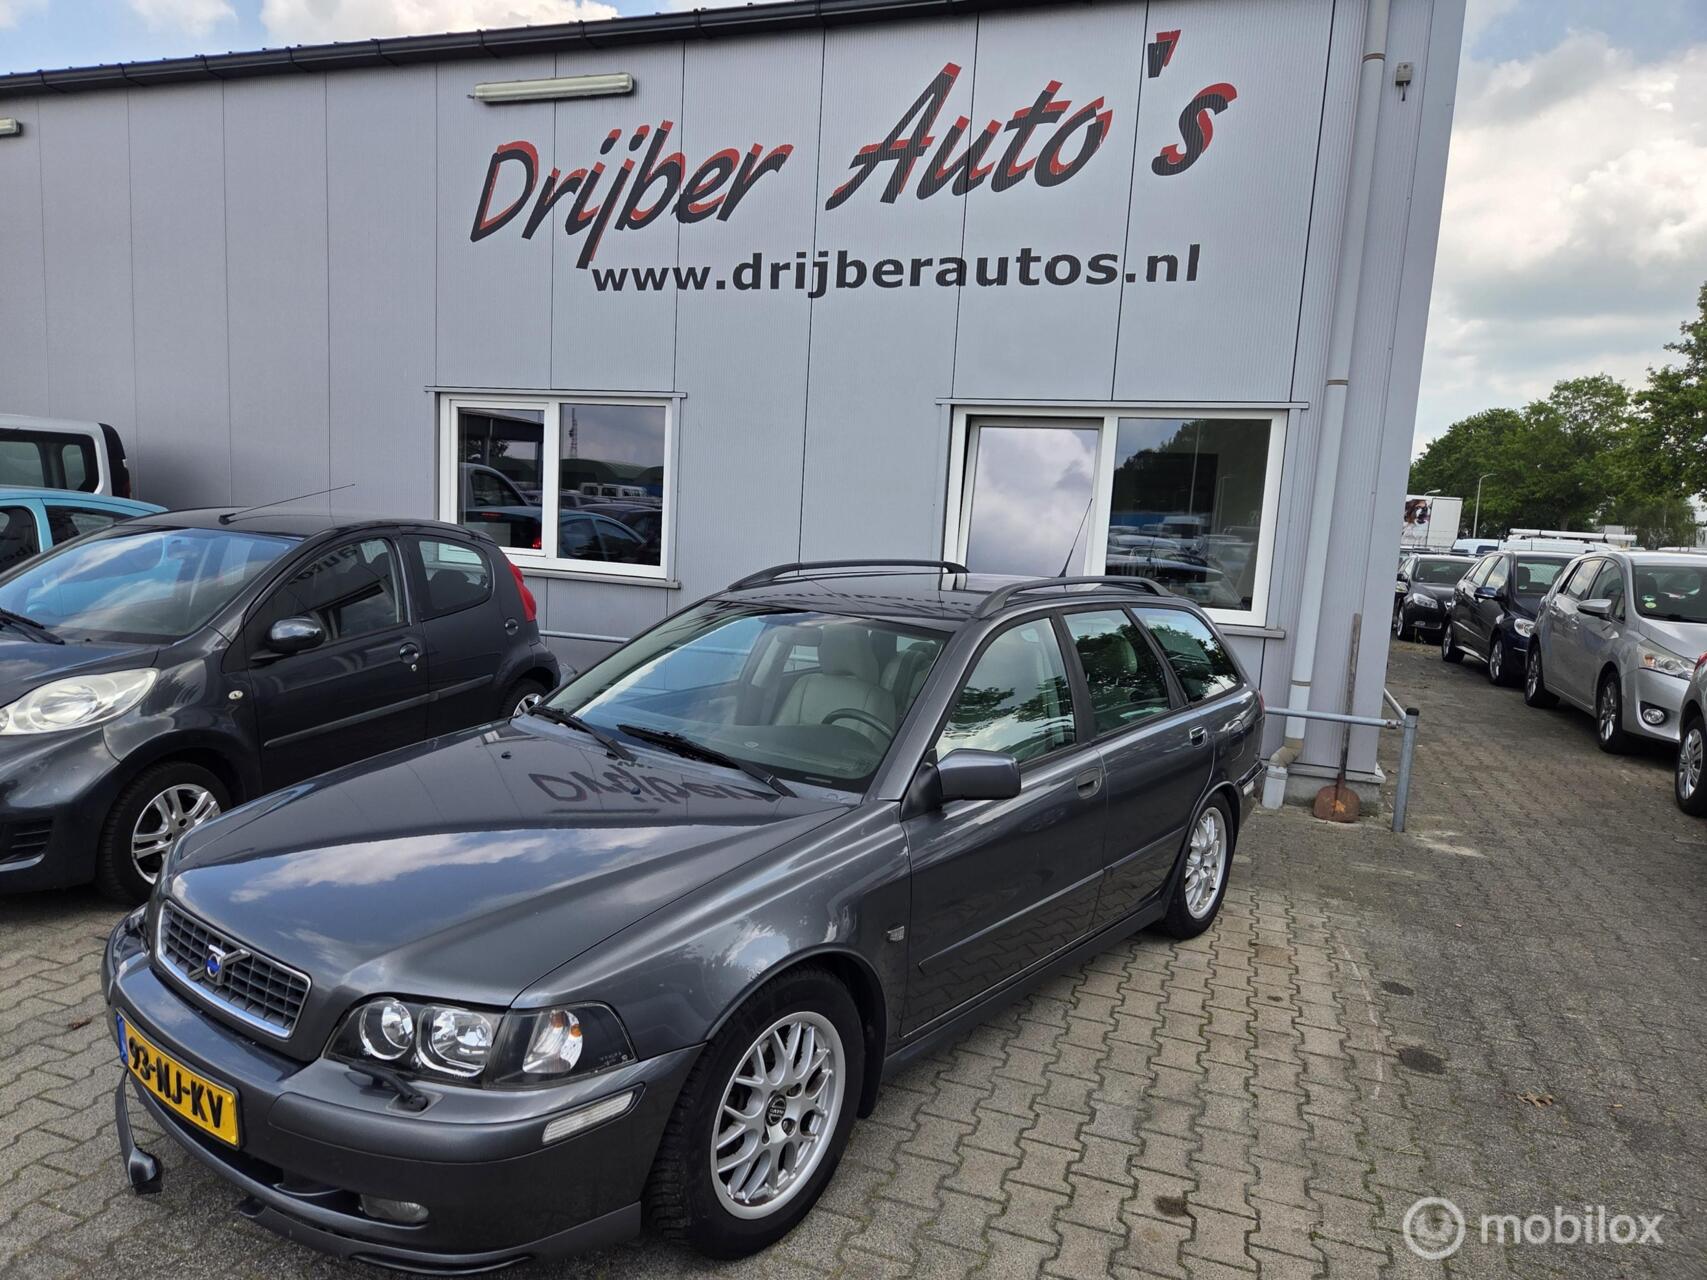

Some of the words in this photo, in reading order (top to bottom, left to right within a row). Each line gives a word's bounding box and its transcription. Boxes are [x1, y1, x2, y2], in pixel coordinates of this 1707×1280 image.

[470, 120, 794, 270] Drijber
[825, 29, 1238, 210] Auto's
[591, 243, 1200, 298] www.drijberautos.nl
[128, 1035, 223, 1129] 93-NJ-KV
